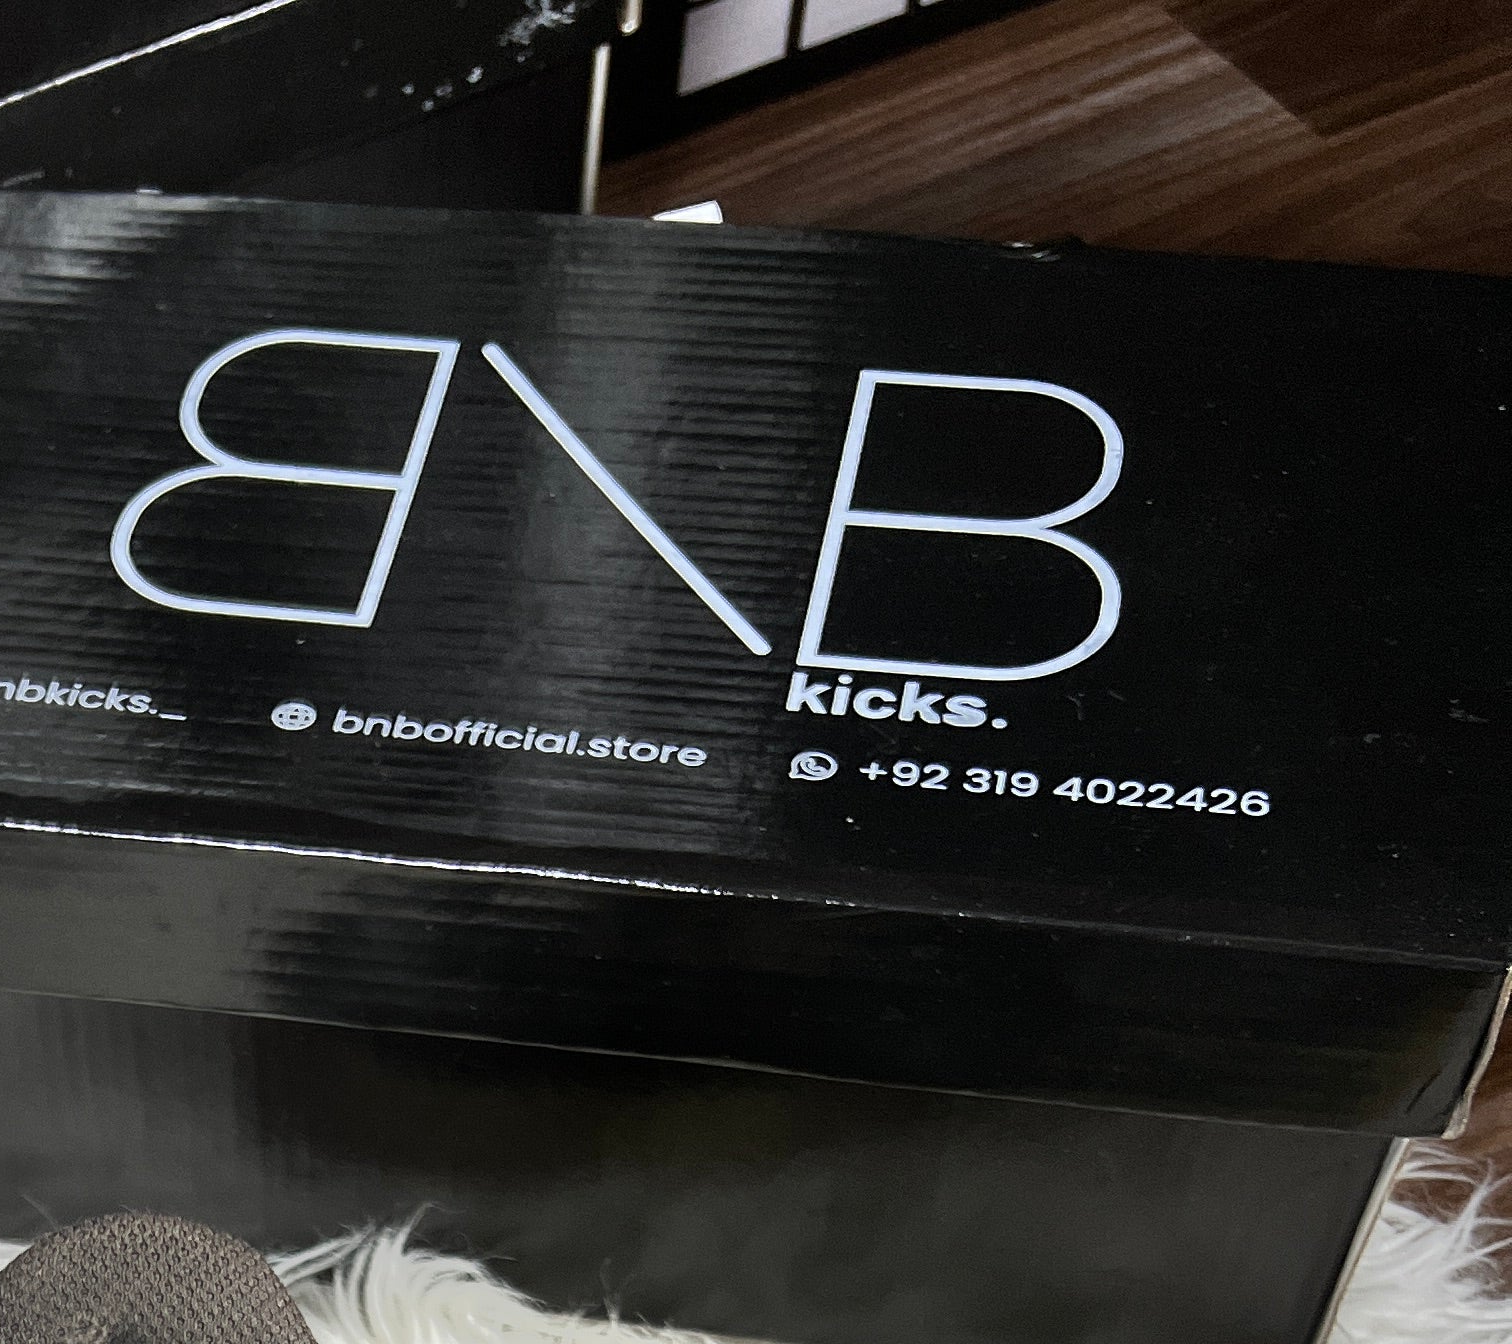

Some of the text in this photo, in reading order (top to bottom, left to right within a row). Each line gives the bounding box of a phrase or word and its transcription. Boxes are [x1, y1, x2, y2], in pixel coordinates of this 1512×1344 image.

[786, 672, 1008, 729] kicks.
[332, 708, 708, 767] bnbofficial.store
[859, 760, 1271, 817] +92 319 4022426
